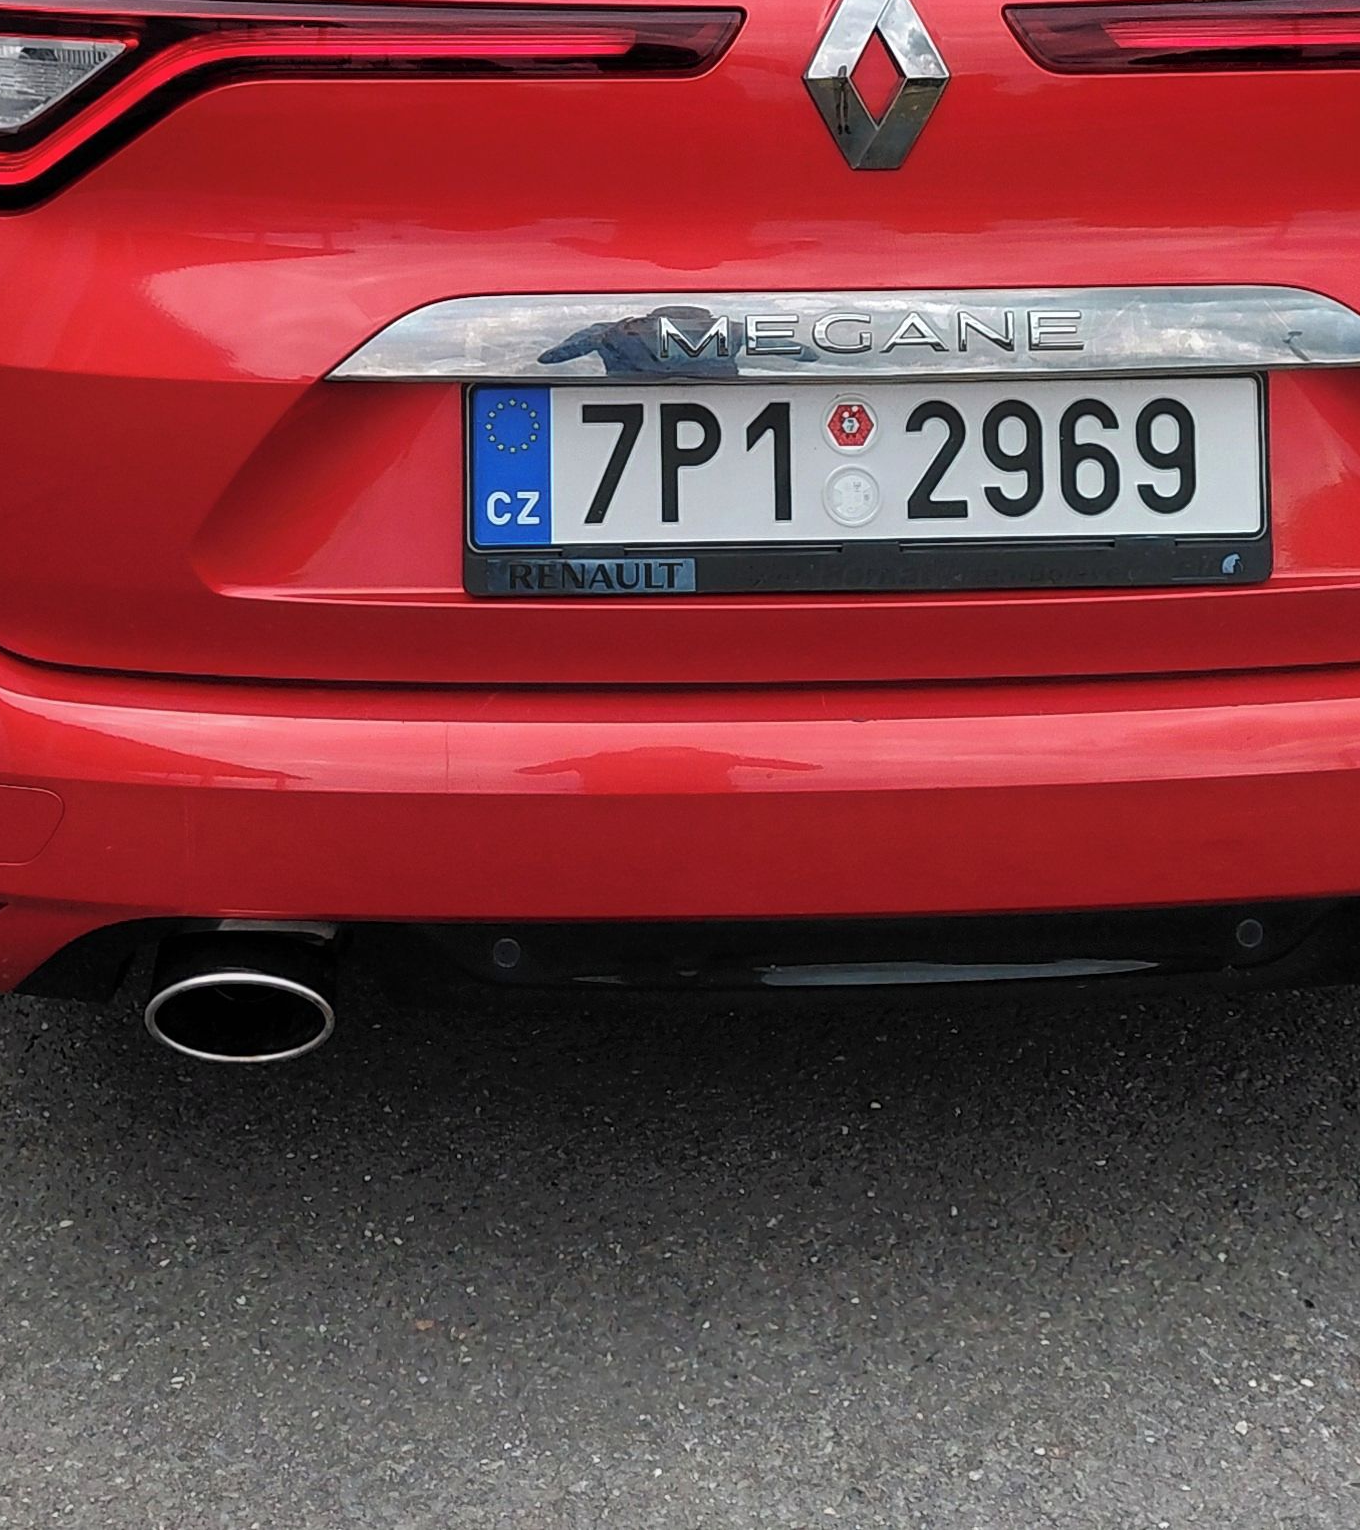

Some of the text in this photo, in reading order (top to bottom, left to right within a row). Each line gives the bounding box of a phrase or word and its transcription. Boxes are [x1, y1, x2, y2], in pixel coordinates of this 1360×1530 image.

[658, 310, 1086, 359] MEGANE
[580, 398, 1198, 525] 7P1 2969
[486, 491, 541, 526] CZ
[508, 562, 684, 590] RENAULT
